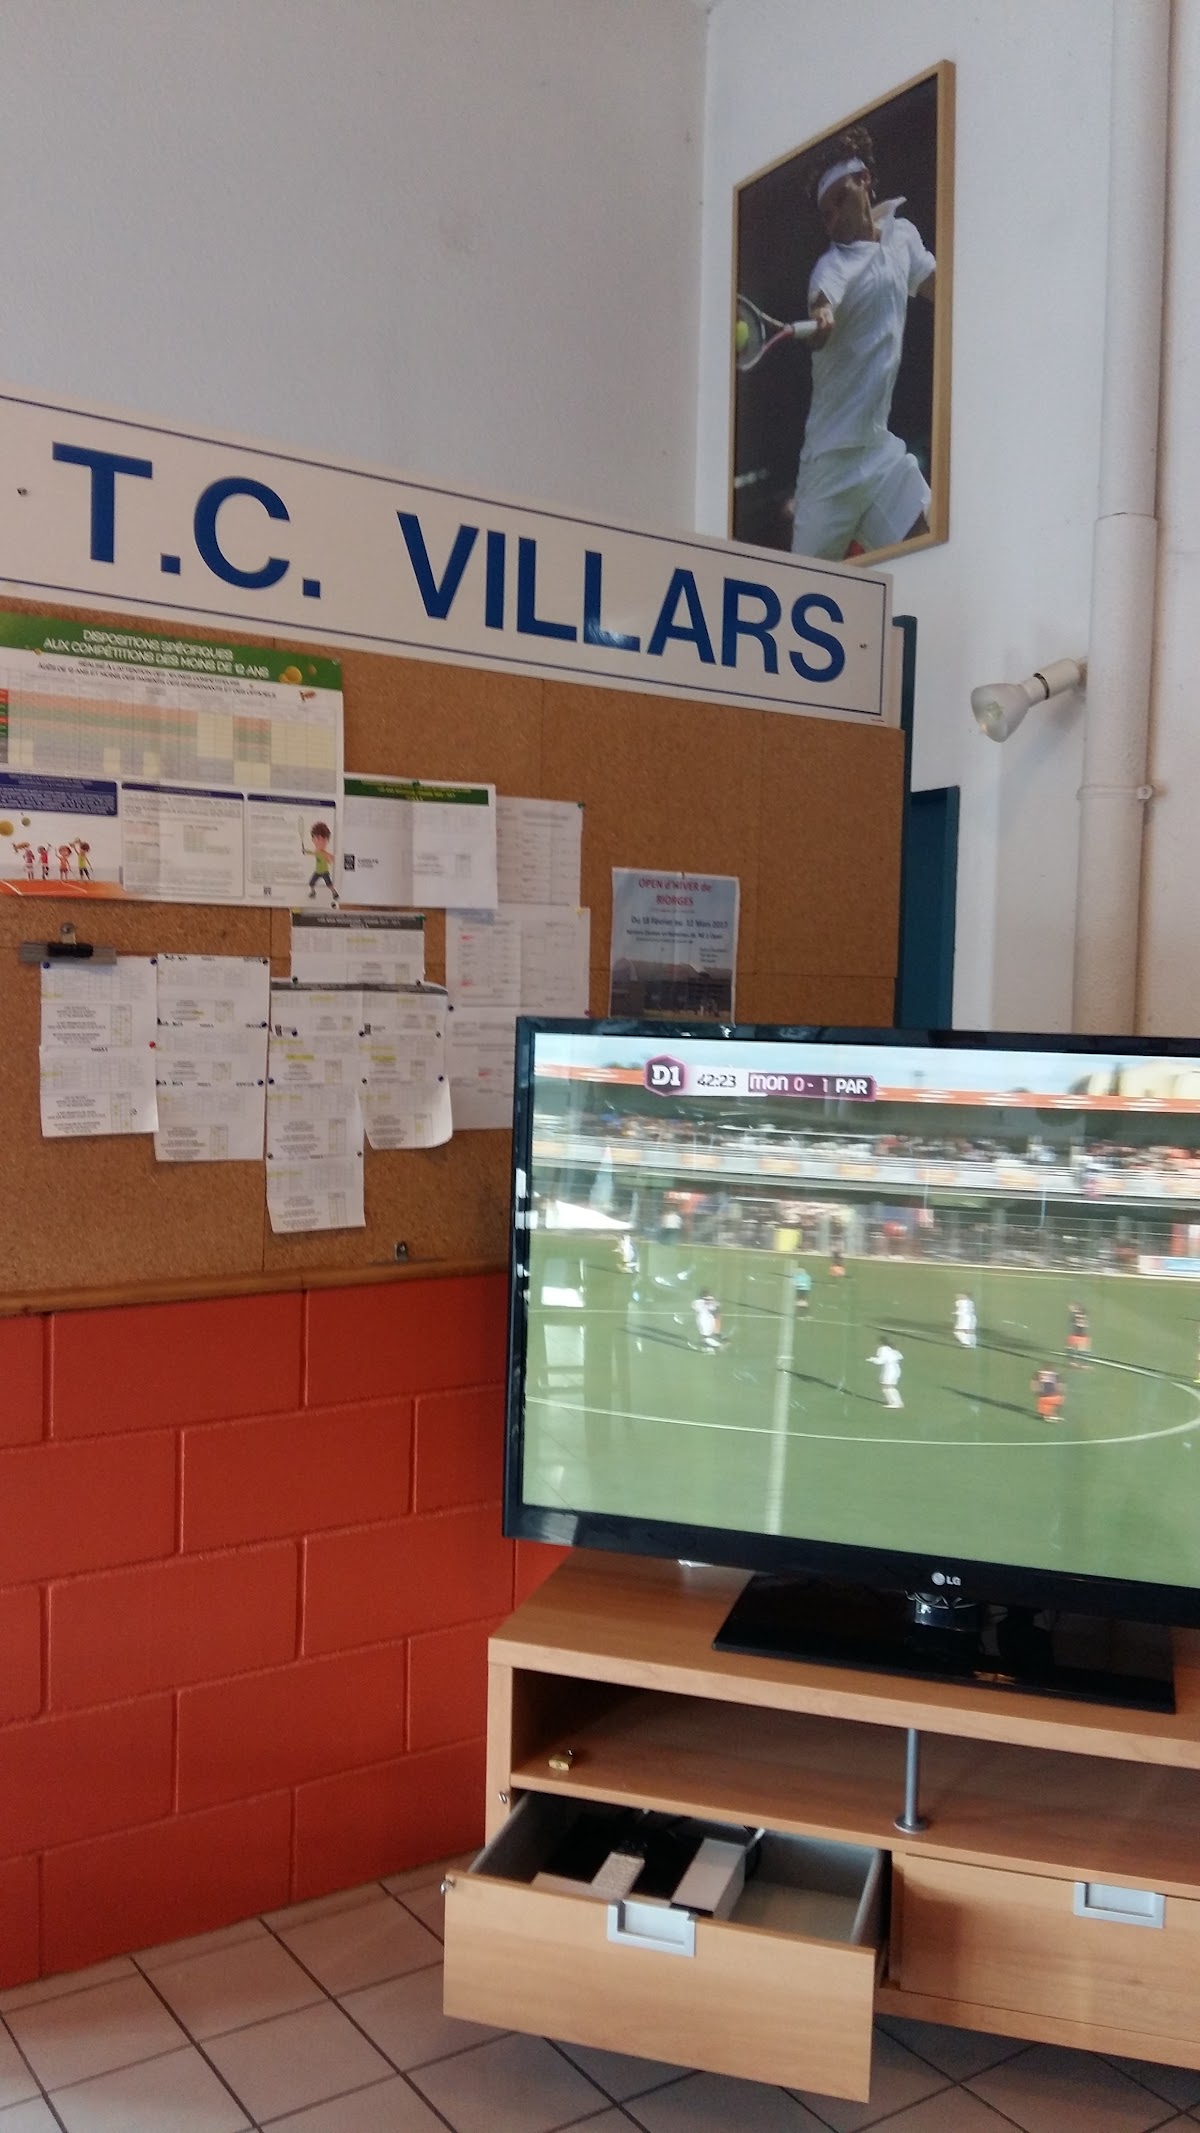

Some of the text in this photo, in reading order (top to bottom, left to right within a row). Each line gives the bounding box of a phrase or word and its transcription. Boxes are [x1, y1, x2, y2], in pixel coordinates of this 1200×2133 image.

[52, 441, 846, 683] T.C. VILLARS
[83, 629, 159, 652] DISPOSITIONS
[43, 637, 70, 652] AUX
[71, 640, 155, 664] COMPÉTITIONS
[156, 652, 179, 667] DES
[180, 655, 216, 672] MOINS
[217, 660, 233, 674] DE
[246, 664, 270, 679] ANS
[638, 878, 663, 889] OPEN
[651, 1064, 681, 1086] D1
[697, 1073, 737, 1089] 42:23
[793, 1076, 805, 1092] 0
[821, 1077, 829, 1093] 1
[835, 1077, 868, 1095] PAR
[945, 1575, 962, 1586] LG
